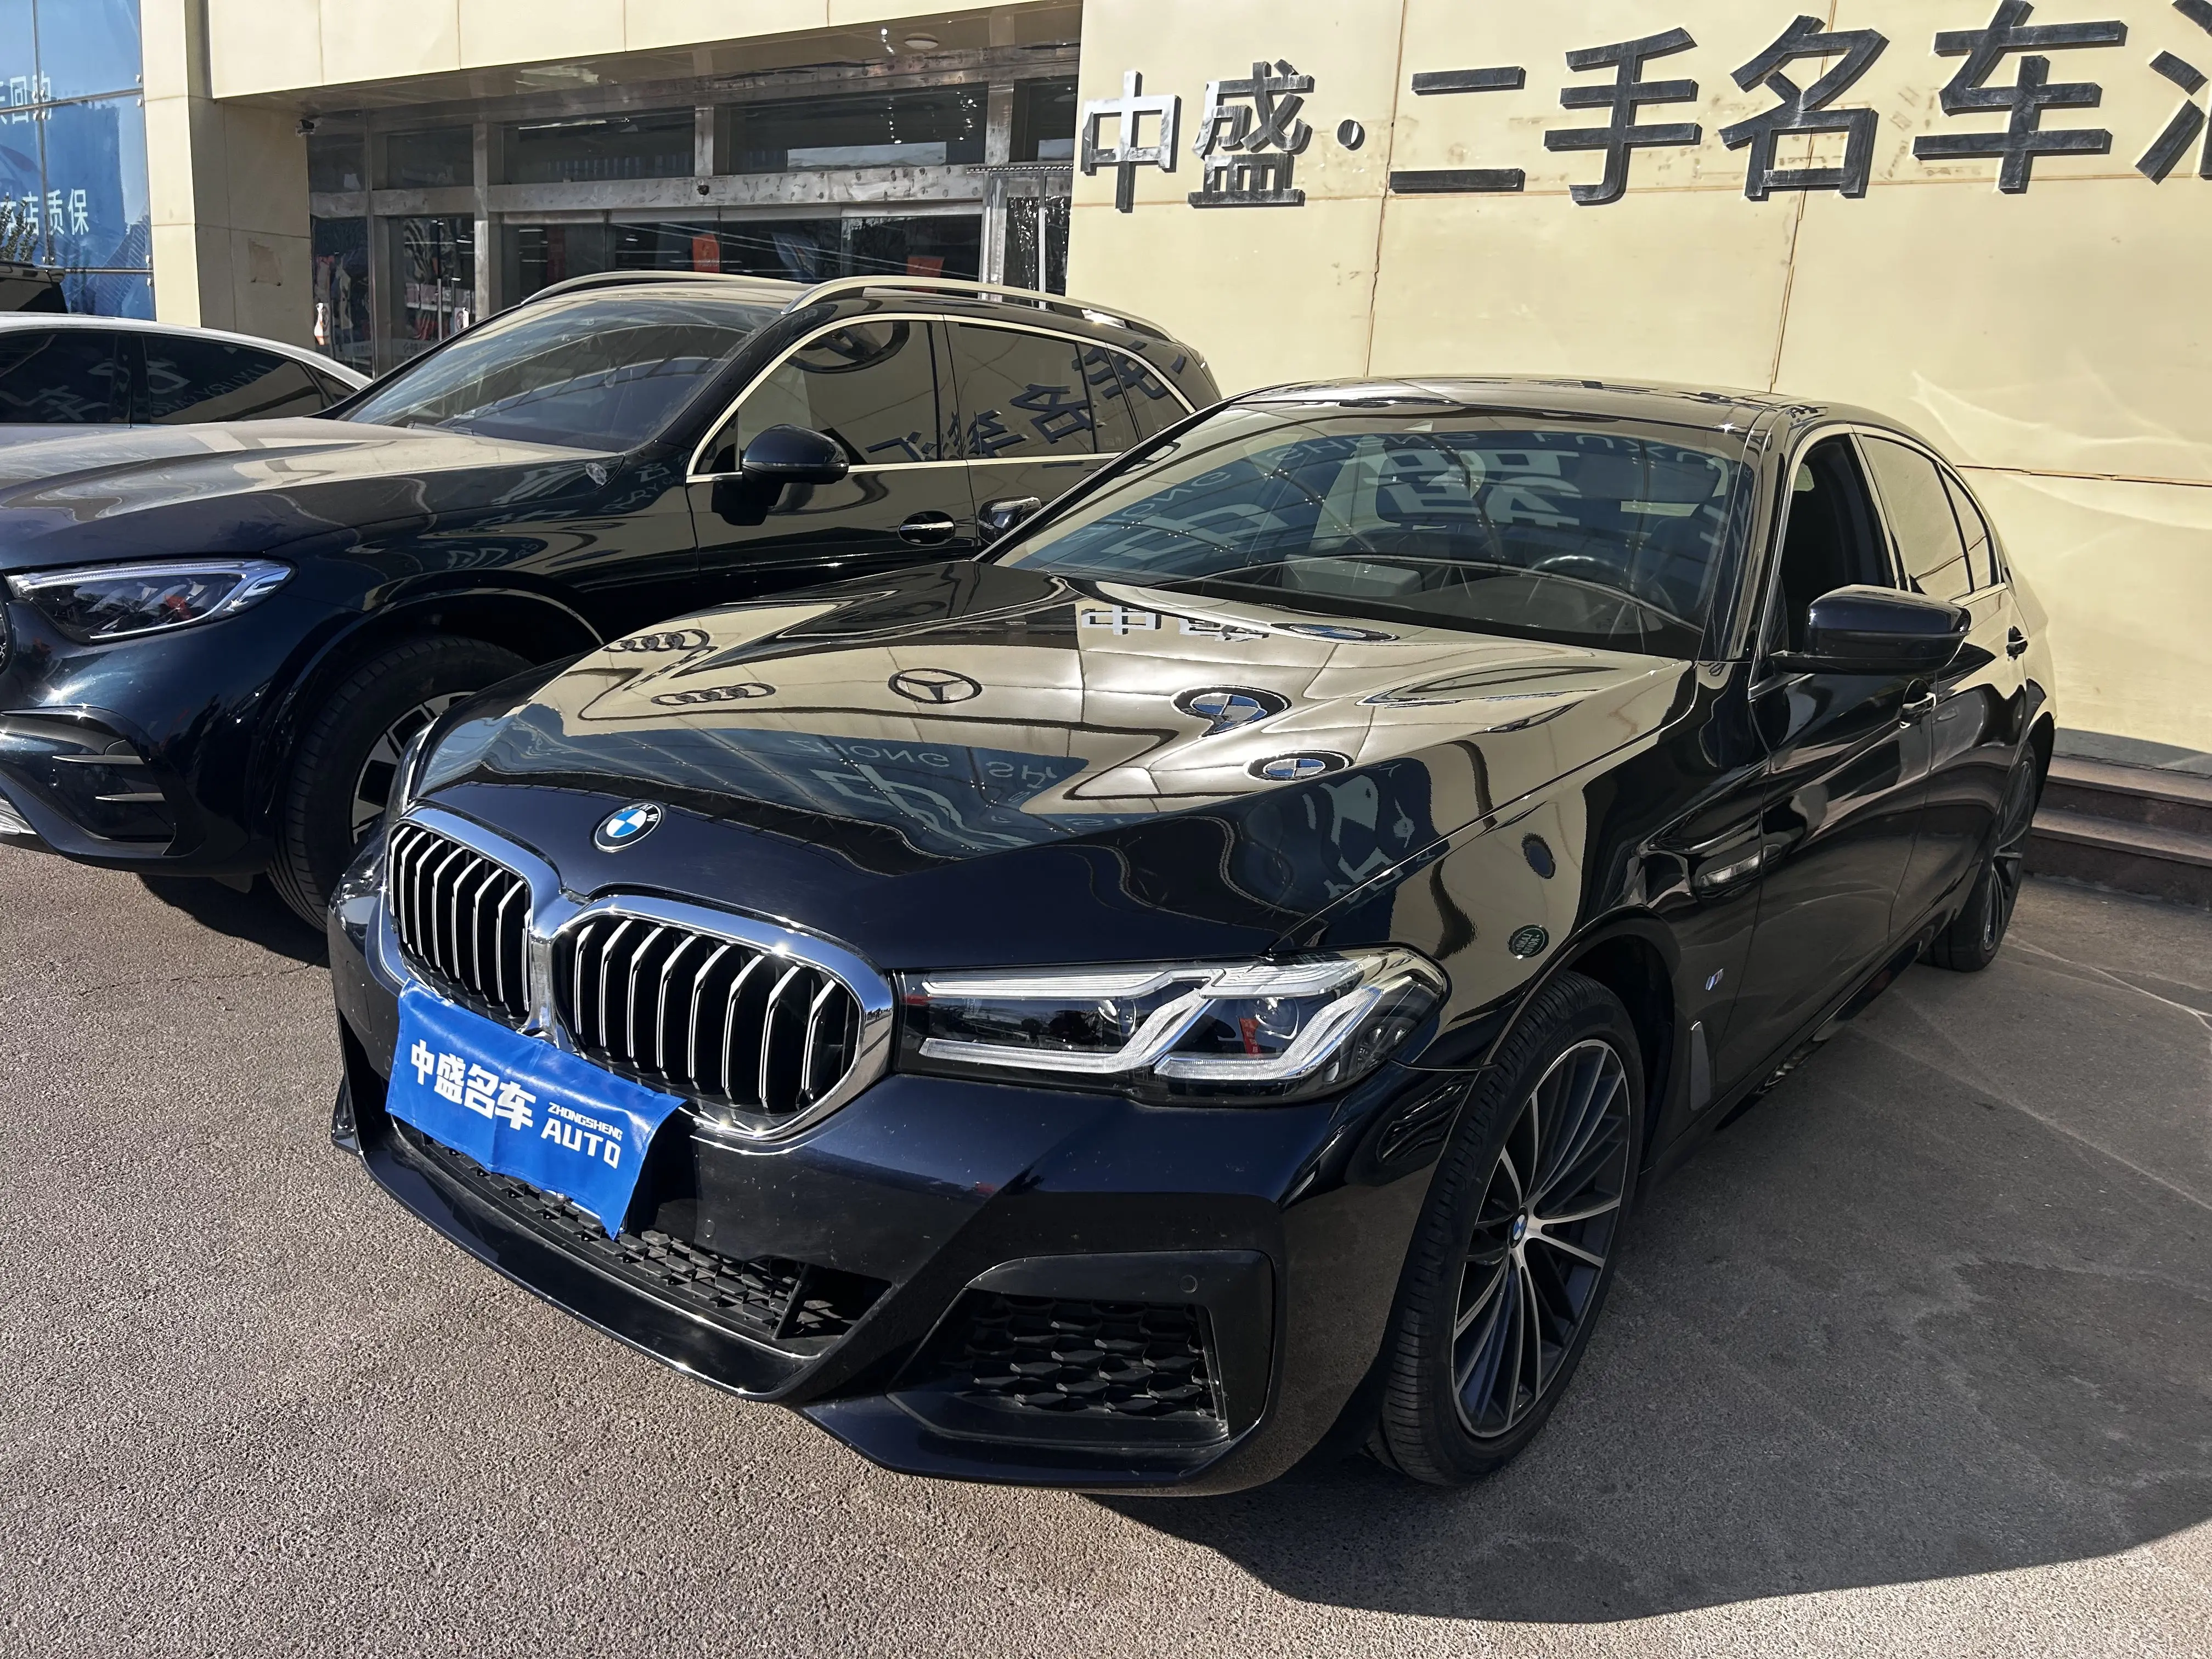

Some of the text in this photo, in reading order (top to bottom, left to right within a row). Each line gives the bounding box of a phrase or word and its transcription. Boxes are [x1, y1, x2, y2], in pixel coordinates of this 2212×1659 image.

[411, 1039, 537, 1130] 中盛名车
[540, 1118, 621, 1169] AUTO
[548, 1102, 623, 1141] ZHONGSHENG
